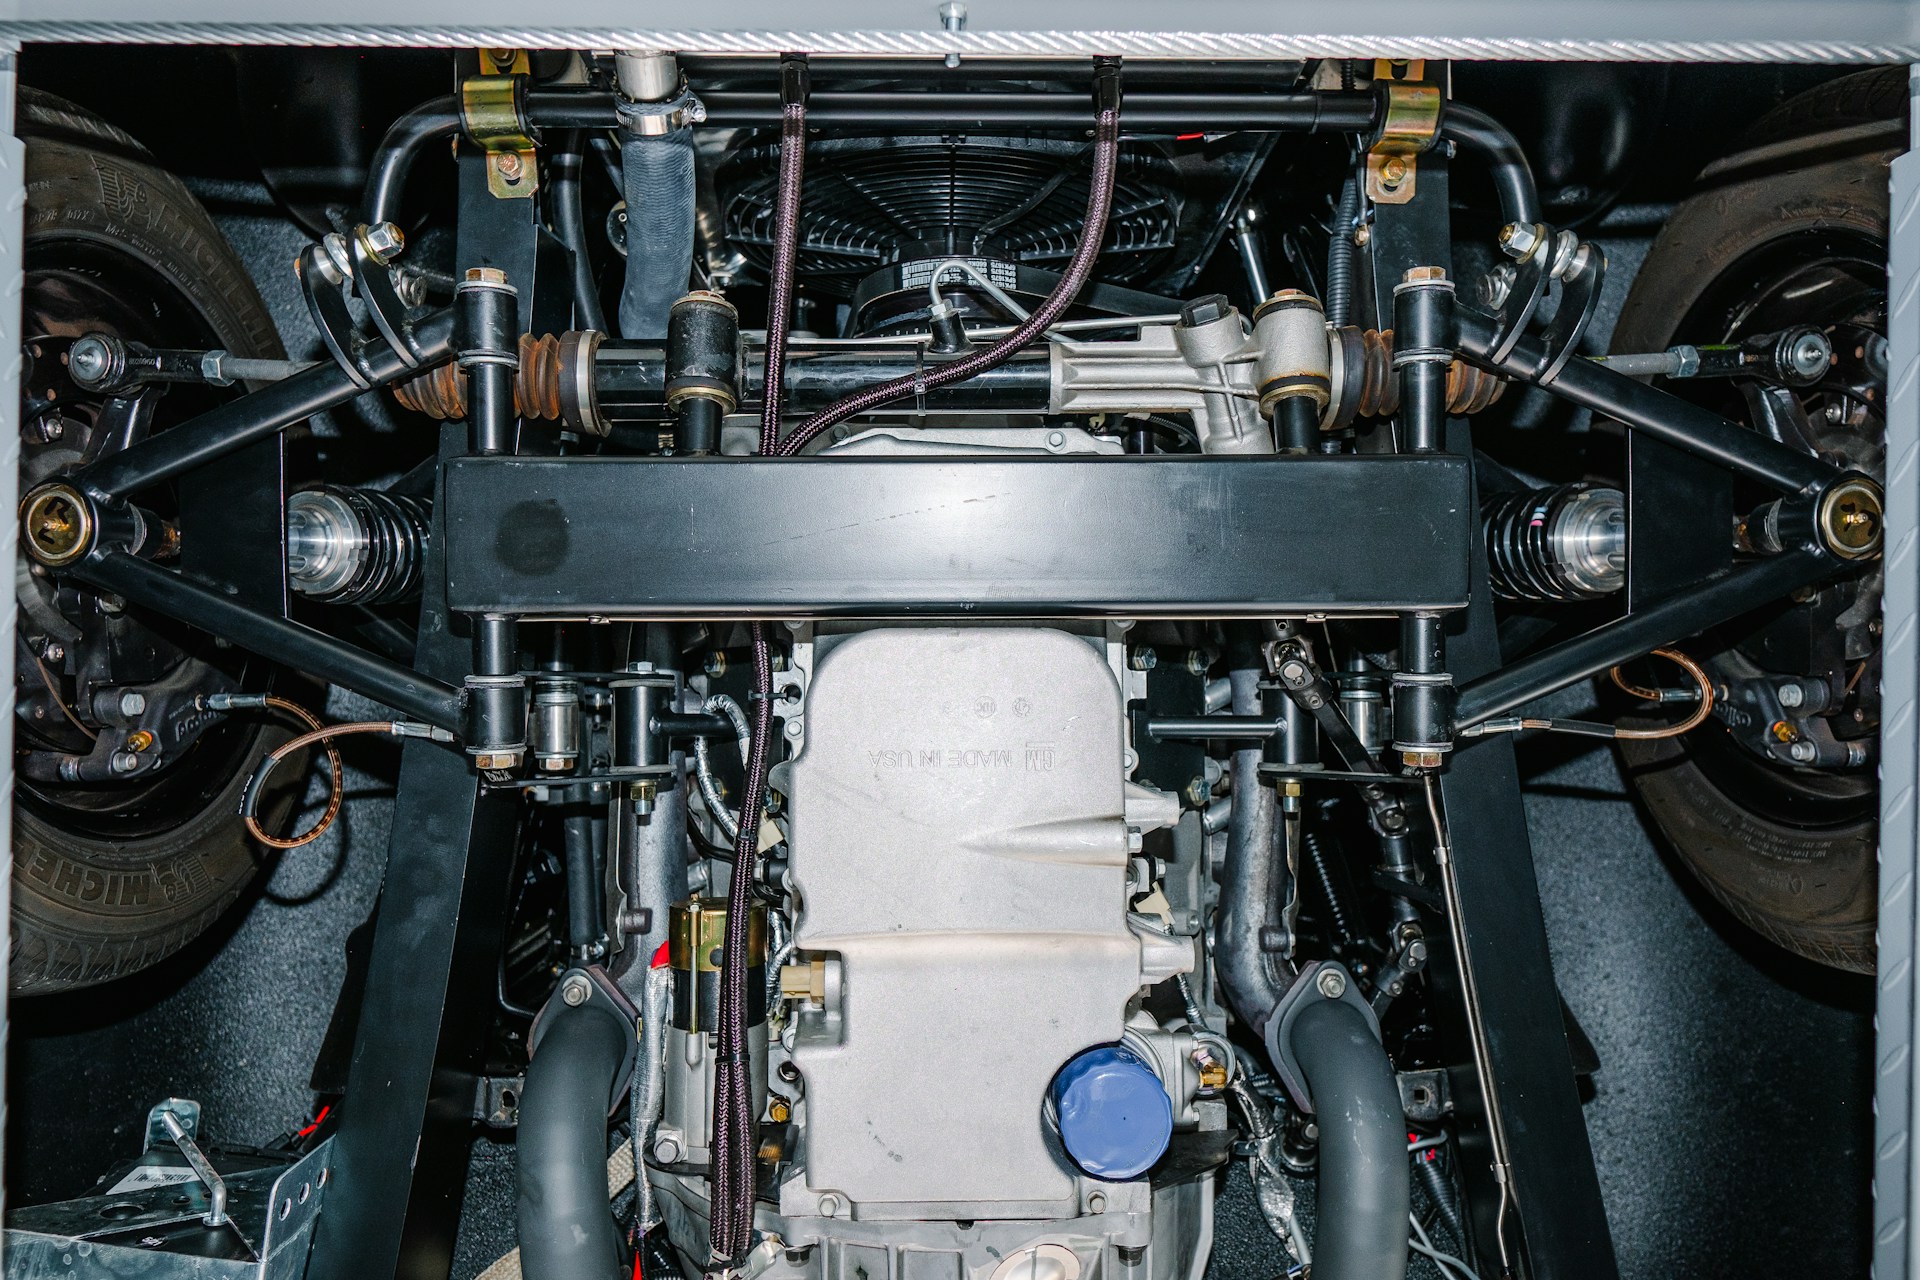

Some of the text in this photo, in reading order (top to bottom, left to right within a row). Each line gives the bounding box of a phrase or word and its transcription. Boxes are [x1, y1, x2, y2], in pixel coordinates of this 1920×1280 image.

[867, 747, 1056, 772] GM MADE IN USA
